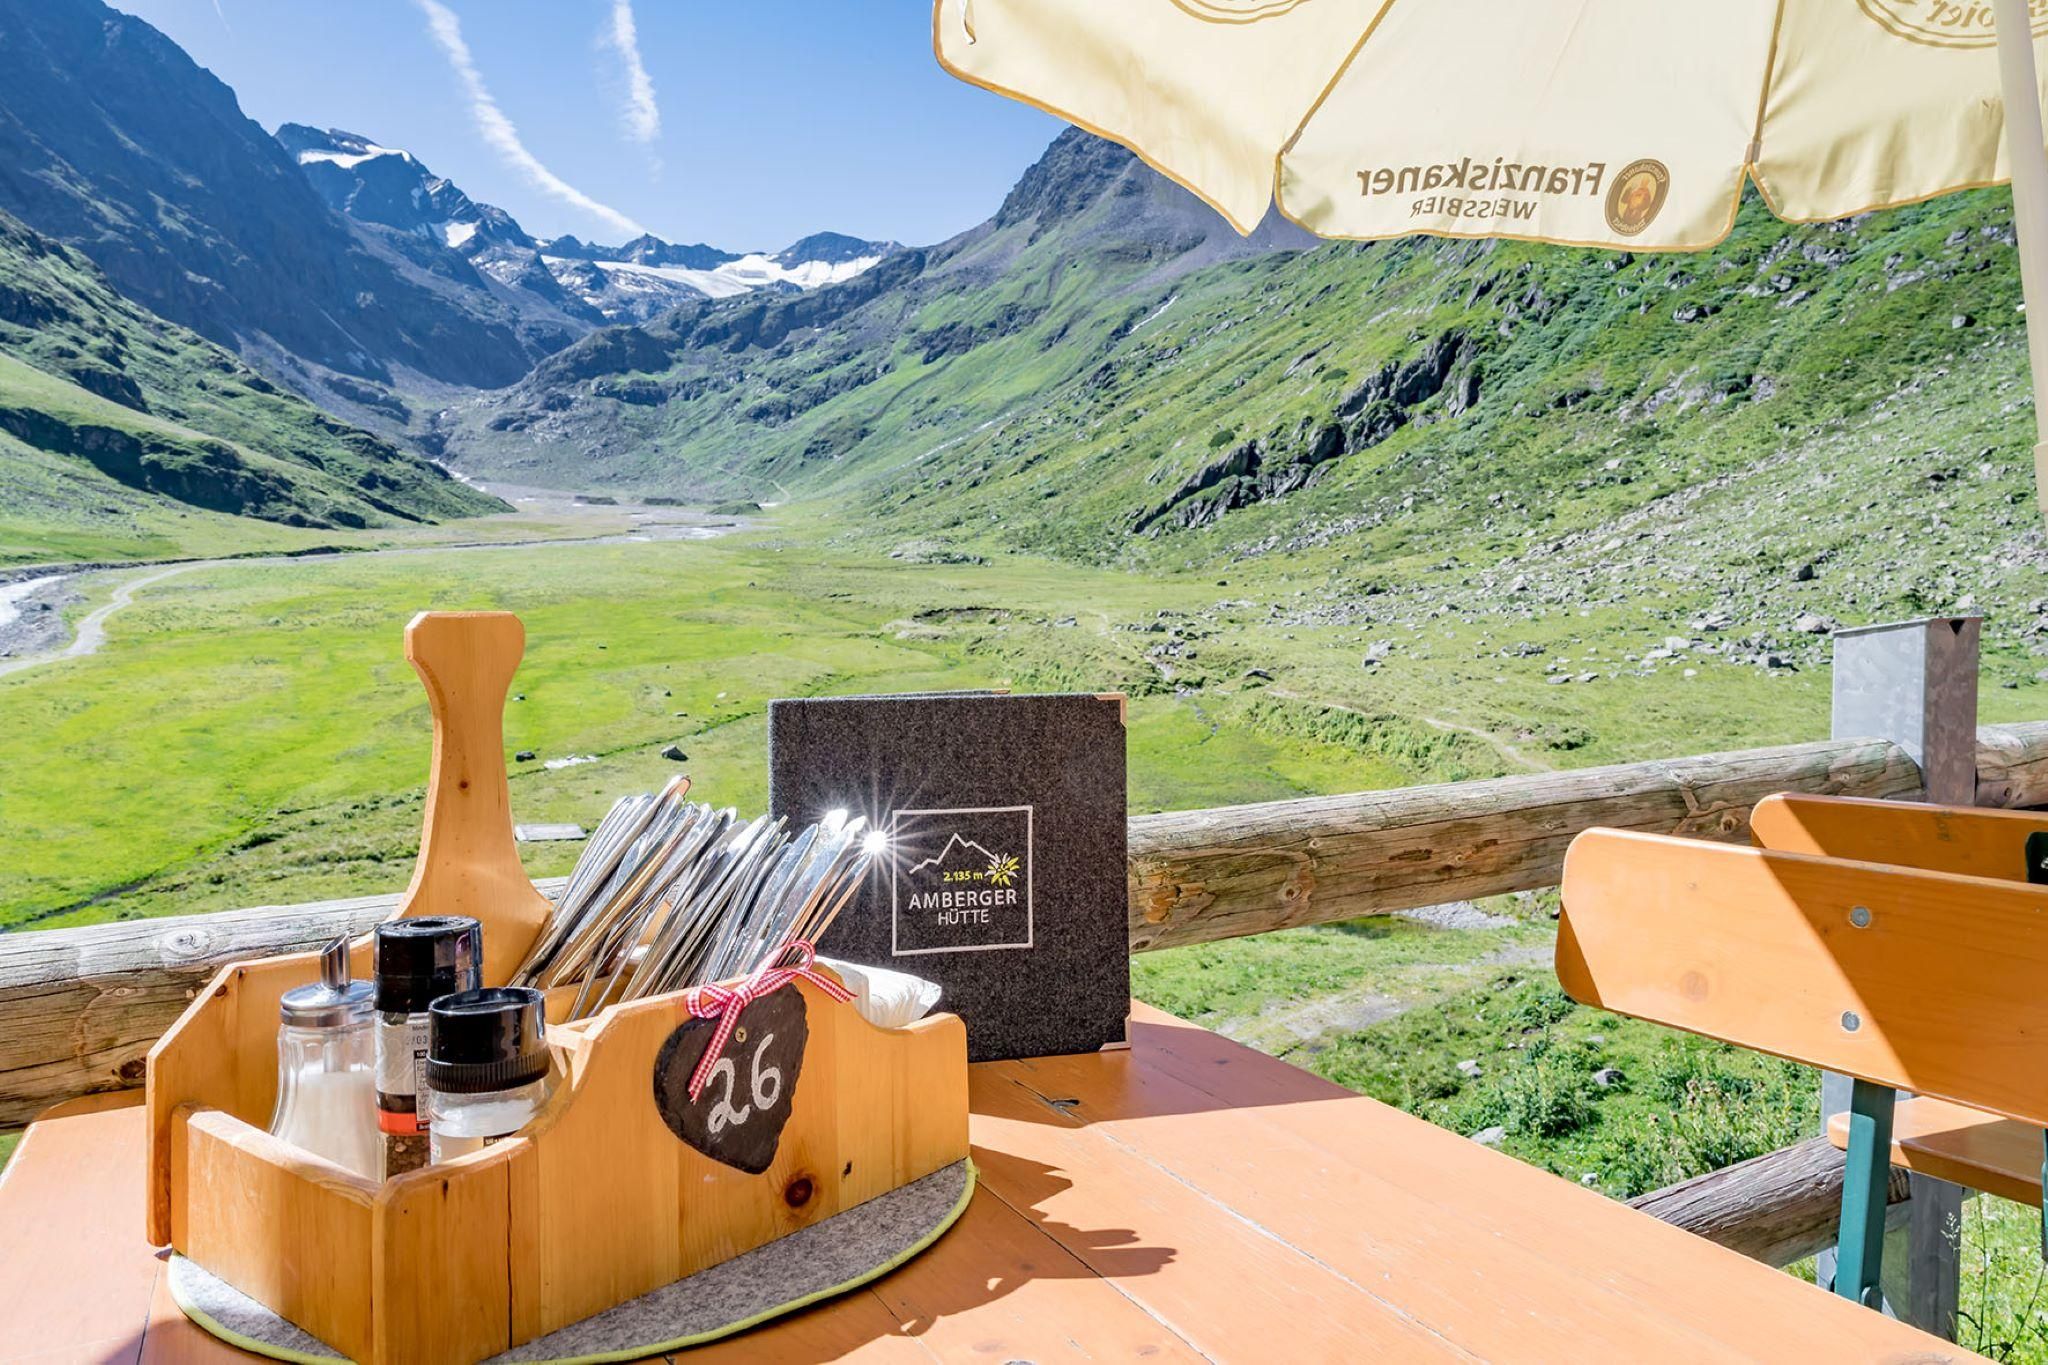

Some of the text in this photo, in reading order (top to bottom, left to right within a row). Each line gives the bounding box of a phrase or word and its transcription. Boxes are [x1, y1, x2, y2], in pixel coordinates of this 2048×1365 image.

[943, 870, 983, 882] 2.135 m
[908, 889, 1017, 910] AMBERGER
[937, 908, 990, 926] HÜTTE
[706, 1033, 781, 1134] 26
